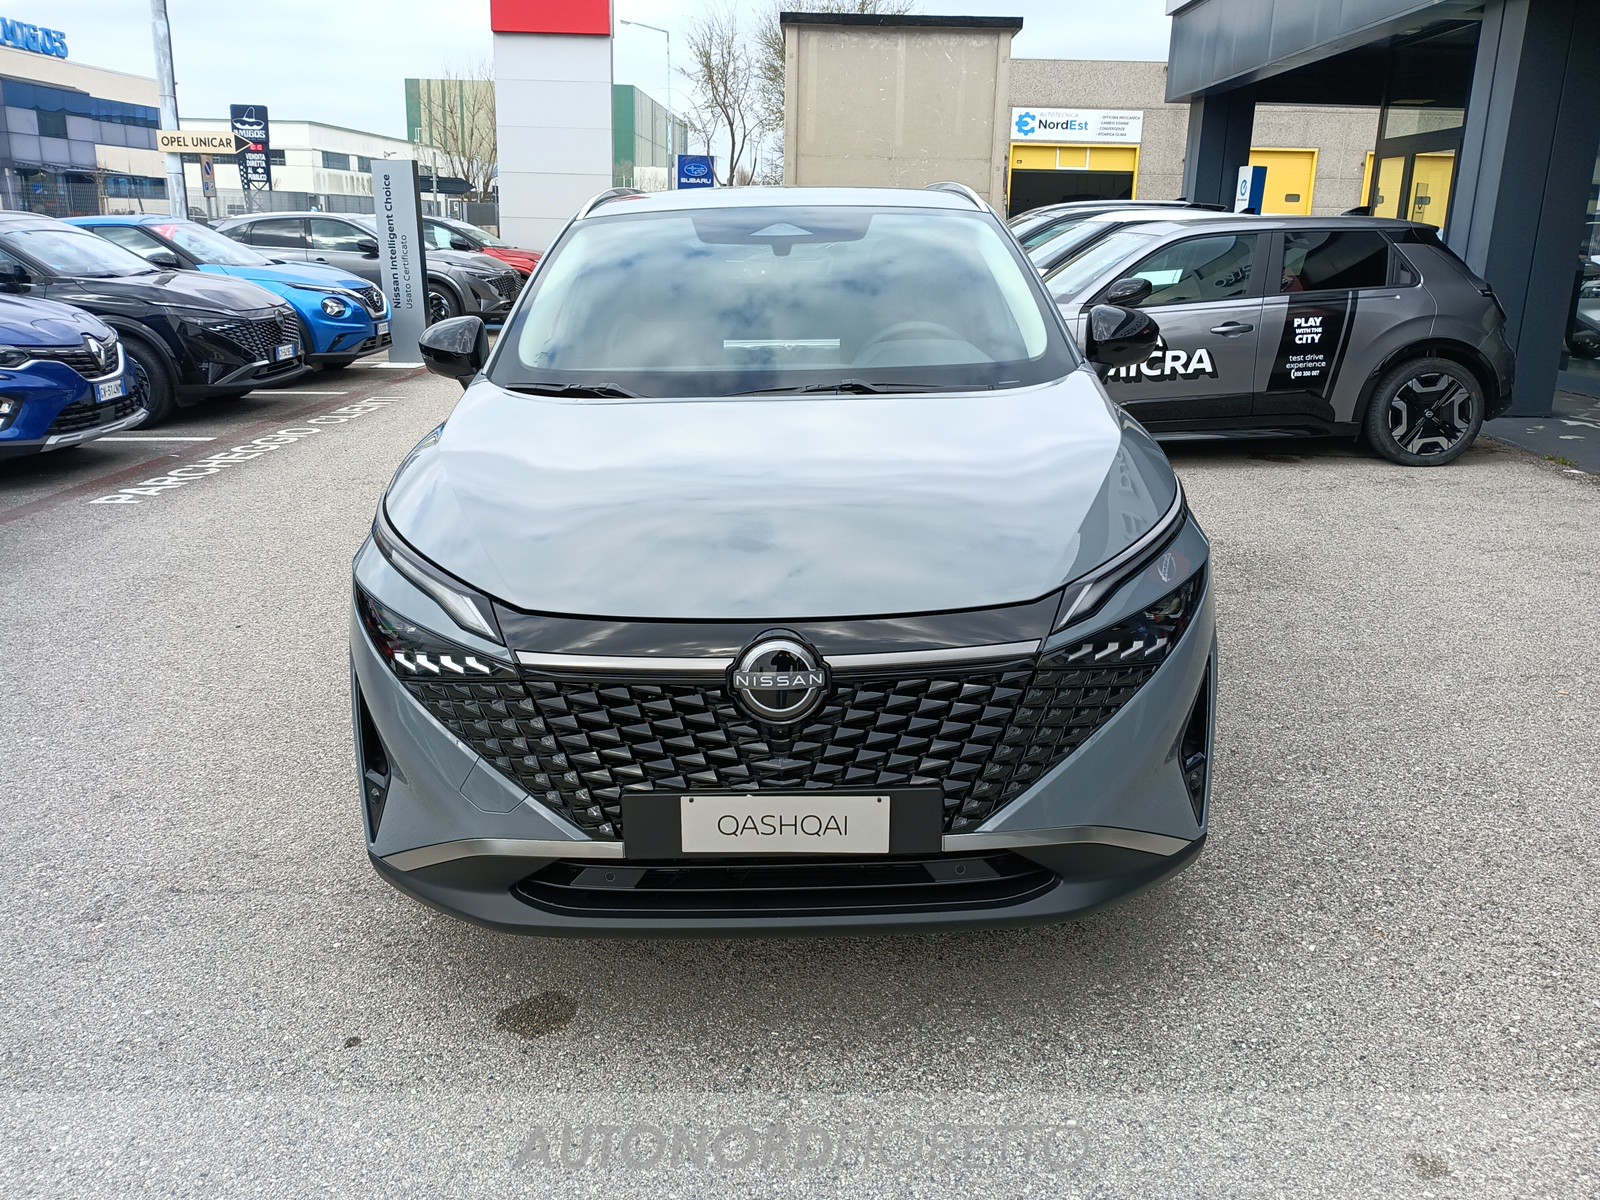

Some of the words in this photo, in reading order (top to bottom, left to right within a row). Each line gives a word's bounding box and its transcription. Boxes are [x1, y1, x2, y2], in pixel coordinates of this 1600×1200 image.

[233, 129, 266, 138] AMIGOS
[1038, 119, 1089, 131] NordEst
[161, 136, 189, 147] OPEL
[191, 137, 233, 148] UNICAR
[382, 174, 392, 212] Choice
[386, 214, 398, 270] Intelligent
[401, 234, 411, 281] Certificato
[391, 272, 402, 309] Nissan
[402, 283, 412, 310] Usato
[1294, 316, 1322, 328] PLAY
[1294, 334, 1322, 344] CITY
[1286, 361, 1326, 370] experience
[88, 427, 322, 504] PARCHEGGIO
[306, 396, 406, 424] CLIENTI
[736, 673, 822, 687] NISSAN
[717, 814, 848, 838] QASHQAI
